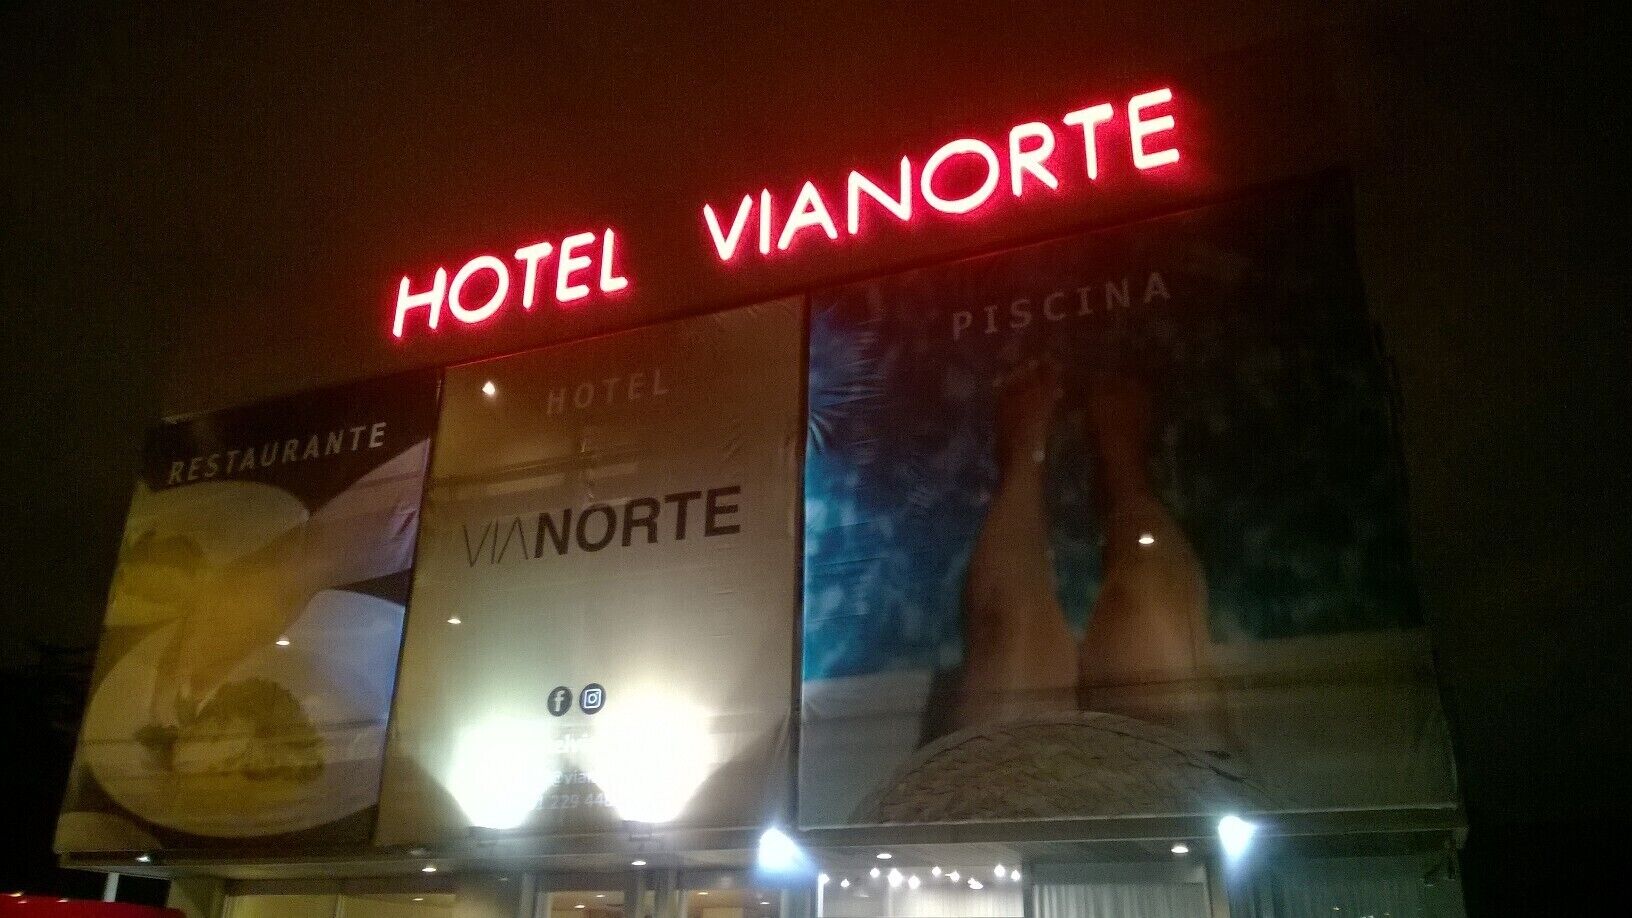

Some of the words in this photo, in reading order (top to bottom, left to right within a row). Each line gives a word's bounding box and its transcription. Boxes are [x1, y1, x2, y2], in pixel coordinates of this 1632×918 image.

[393, 228, 629, 338] HOTEL
[703, 87, 1181, 262] VIANORTE
[952, 272, 1171, 341] PISCINA
[546, 368, 670, 416] HOTEL
[168, 421, 387, 485] RESTAURANTE
[462, 485, 742, 568] VIANORTE
